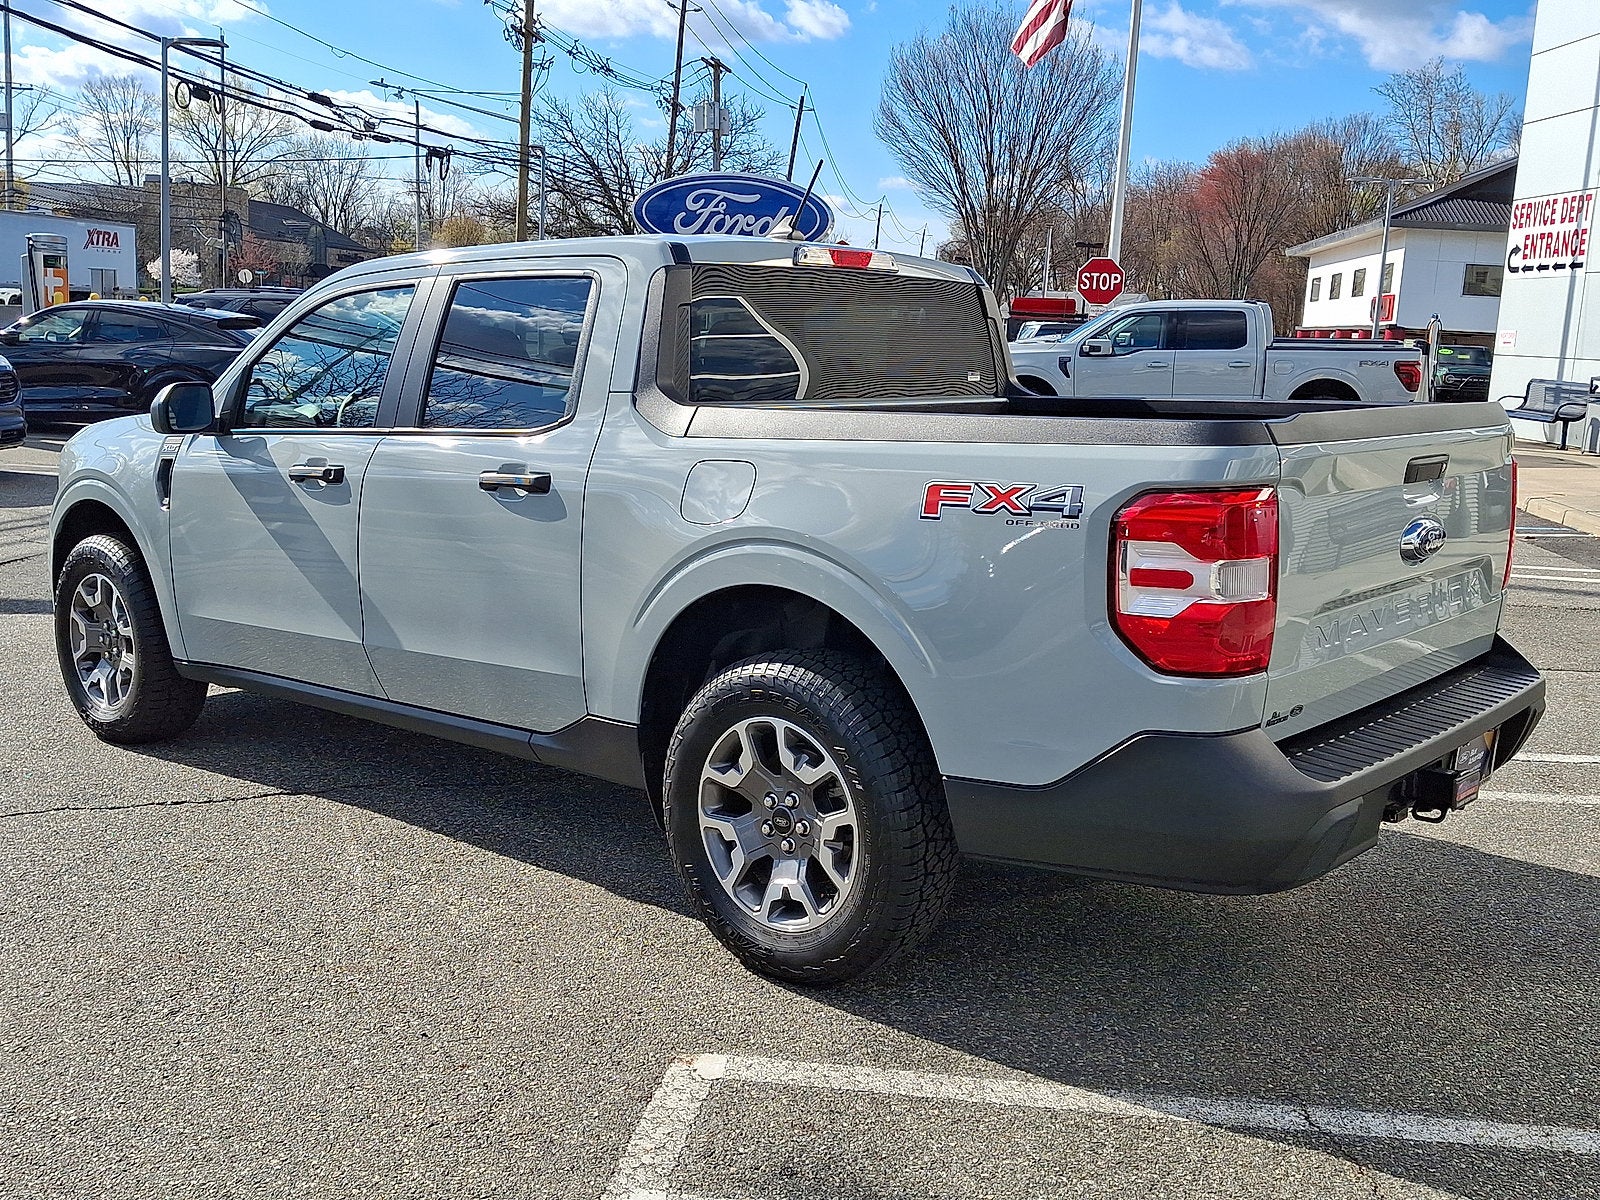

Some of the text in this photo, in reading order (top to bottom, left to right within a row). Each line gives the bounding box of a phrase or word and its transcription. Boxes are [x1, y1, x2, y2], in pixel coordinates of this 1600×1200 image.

[674, 189, 790, 236] Ford
[1512, 194, 1593, 230] SERVICE DEPT
[83, 228, 119, 250] XTRA
[1522, 228, 1588, 260] ENTRANCE
[1080, 272, 1121, 291] STOP
[918, 479, 1085, 521] FX4
[1005, 519, 1034, 527] OFF
[1314, 571, 1483, 650] MAVERICK
